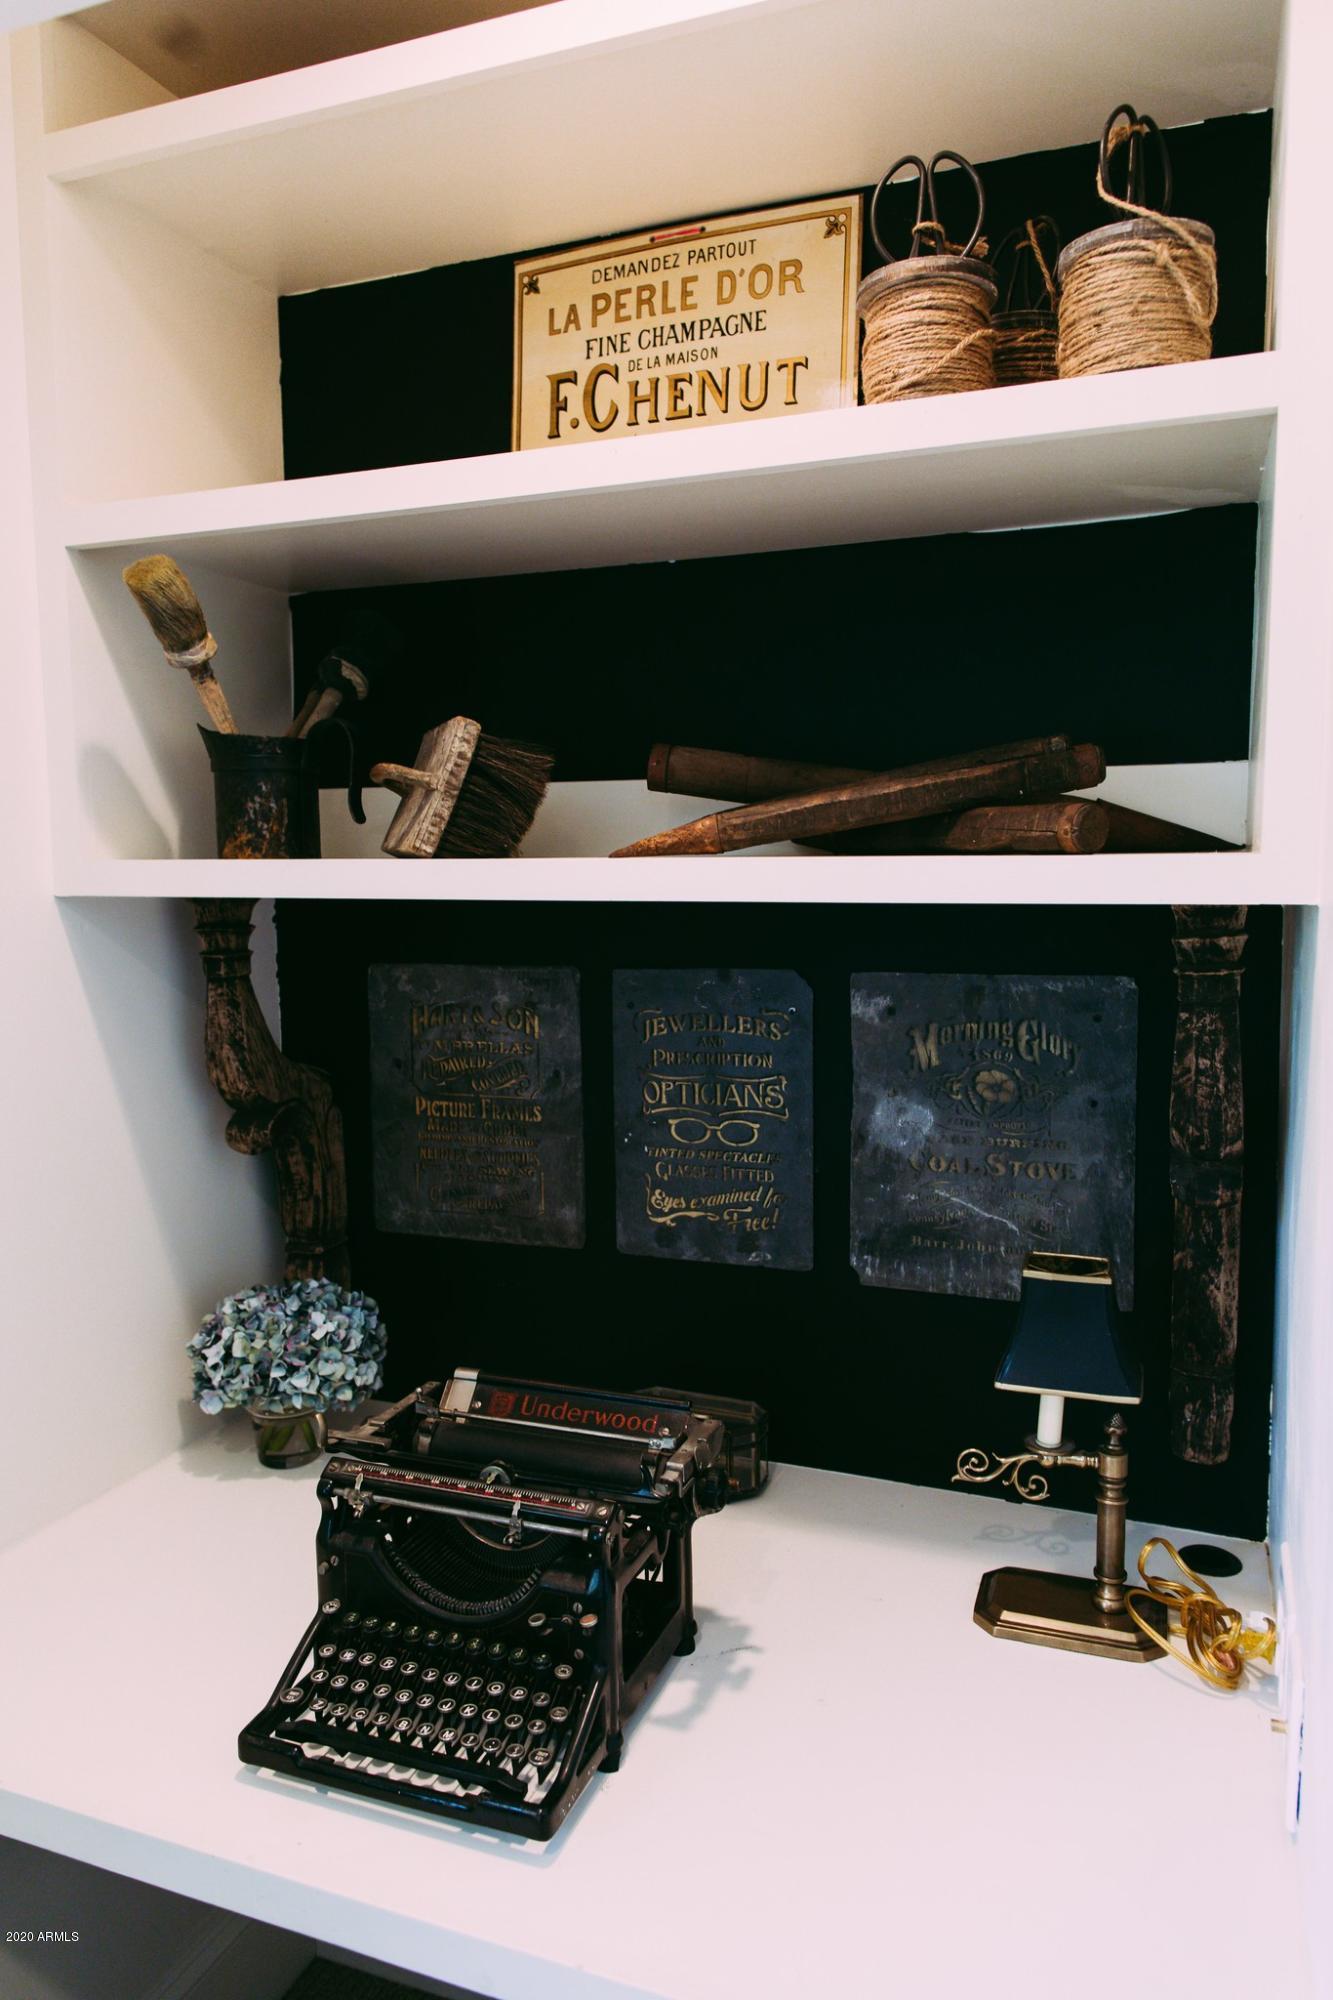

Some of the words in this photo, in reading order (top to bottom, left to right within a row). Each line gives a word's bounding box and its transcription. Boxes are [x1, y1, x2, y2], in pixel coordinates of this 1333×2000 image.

[592, 253, 680, 284] DEMANDEZ
[688, 239, 757, 265] PARTOUT
[548, 303, 581, 336] LA
[590, 275, 699, 328] PERLE
[716, 258, 806, 305] D'OR
[585, 332, 631, 360] FINE
[638, 309, 768, 351] CHAMPAGNE
[627, 358, 643, 373] DE
[647, 355, 662, 370] LA
[665, 346, 719, 366] MAISON
[489, 1002, 541, 1040] SON
[641, 1014, 782, 1043] JEWELLERS
[650, 1048, 774, 1068] PRESCRIPTION
[910, 1020, 1014, 1074] Morning
[415, 1095, 476, 1118] PICTURE
[480, 1098, 543, 1122] FRAMES
[643, 1081, 785, 1109] OPTICIANS
[723, 1166, 775, 1183] FITTED
[985, 1152, 1079, 1181] STOVE
[650, 1188, 687, 1213] Eyes
[690, 1185, 763, 1209] examined
[520, 1395, 660, 1435] Underwood
